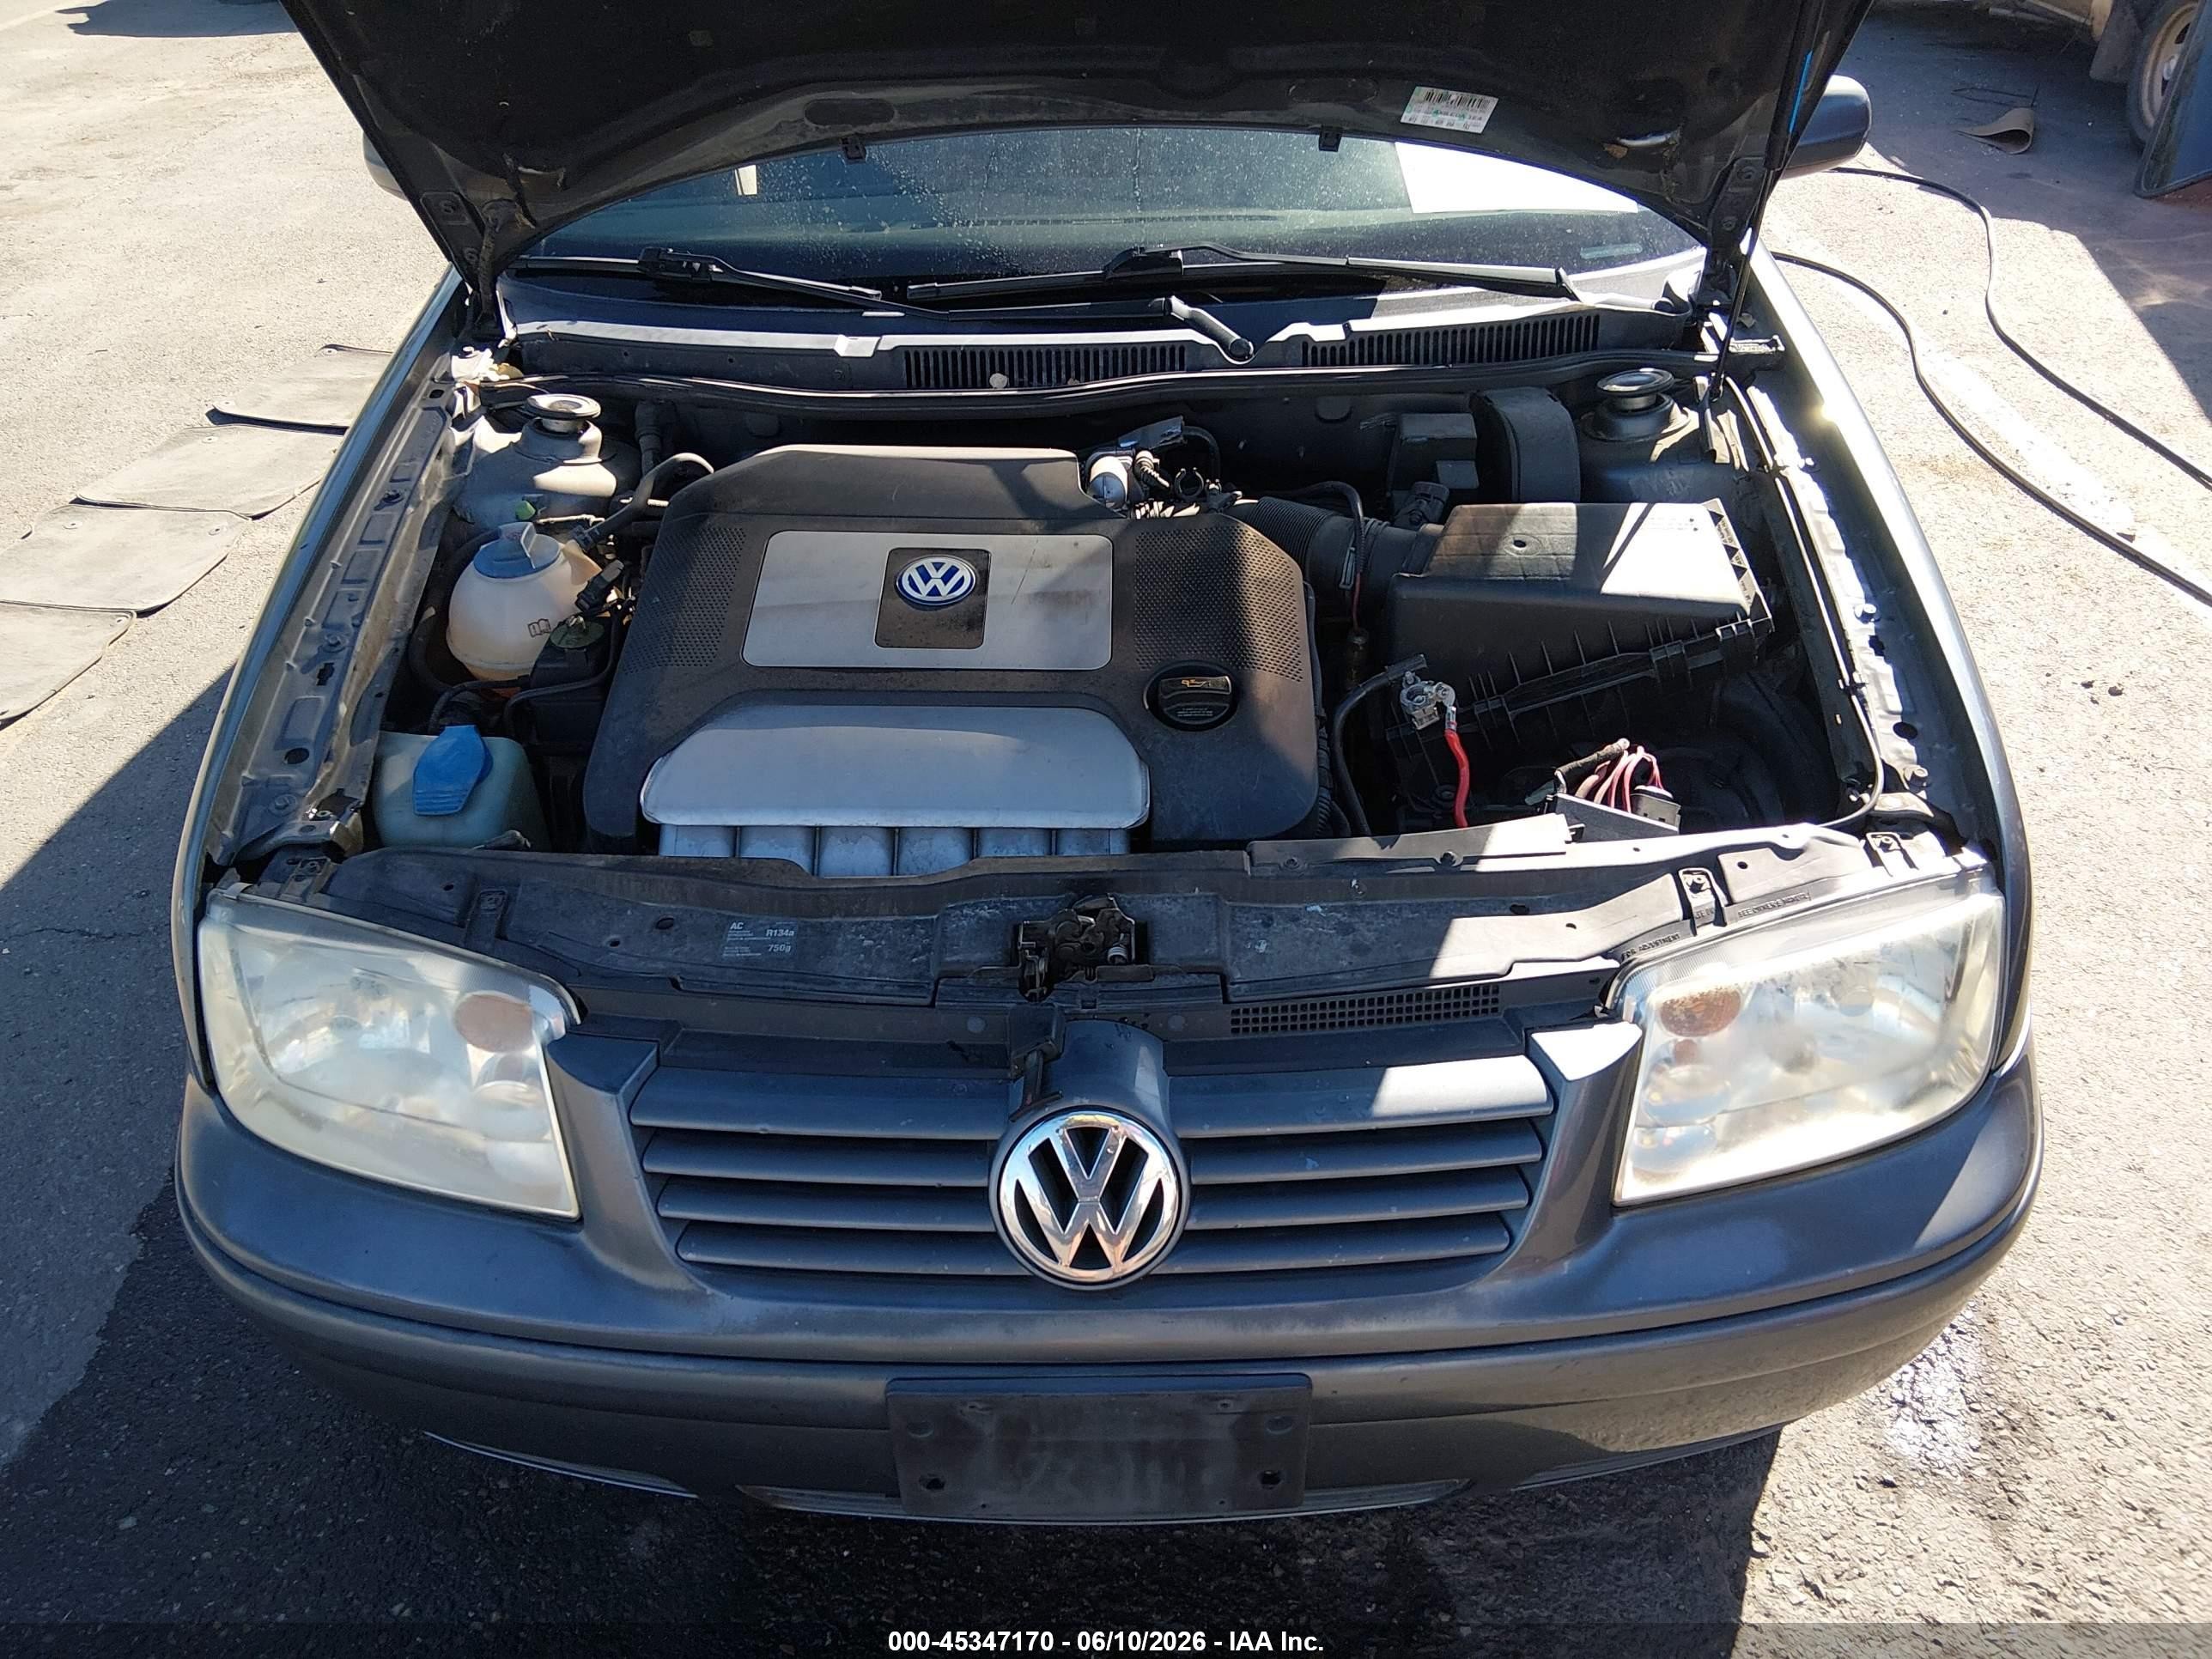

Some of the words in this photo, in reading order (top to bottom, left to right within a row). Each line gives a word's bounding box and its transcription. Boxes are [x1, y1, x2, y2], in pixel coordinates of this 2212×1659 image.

[898, 556, 975, 603] VW
[730, 921, 744, 930] AC
[766, 928, 794, 937] R134a
[768, 943, 792, 954] 750g
[1000, 1111, 1179, 1282] VW
